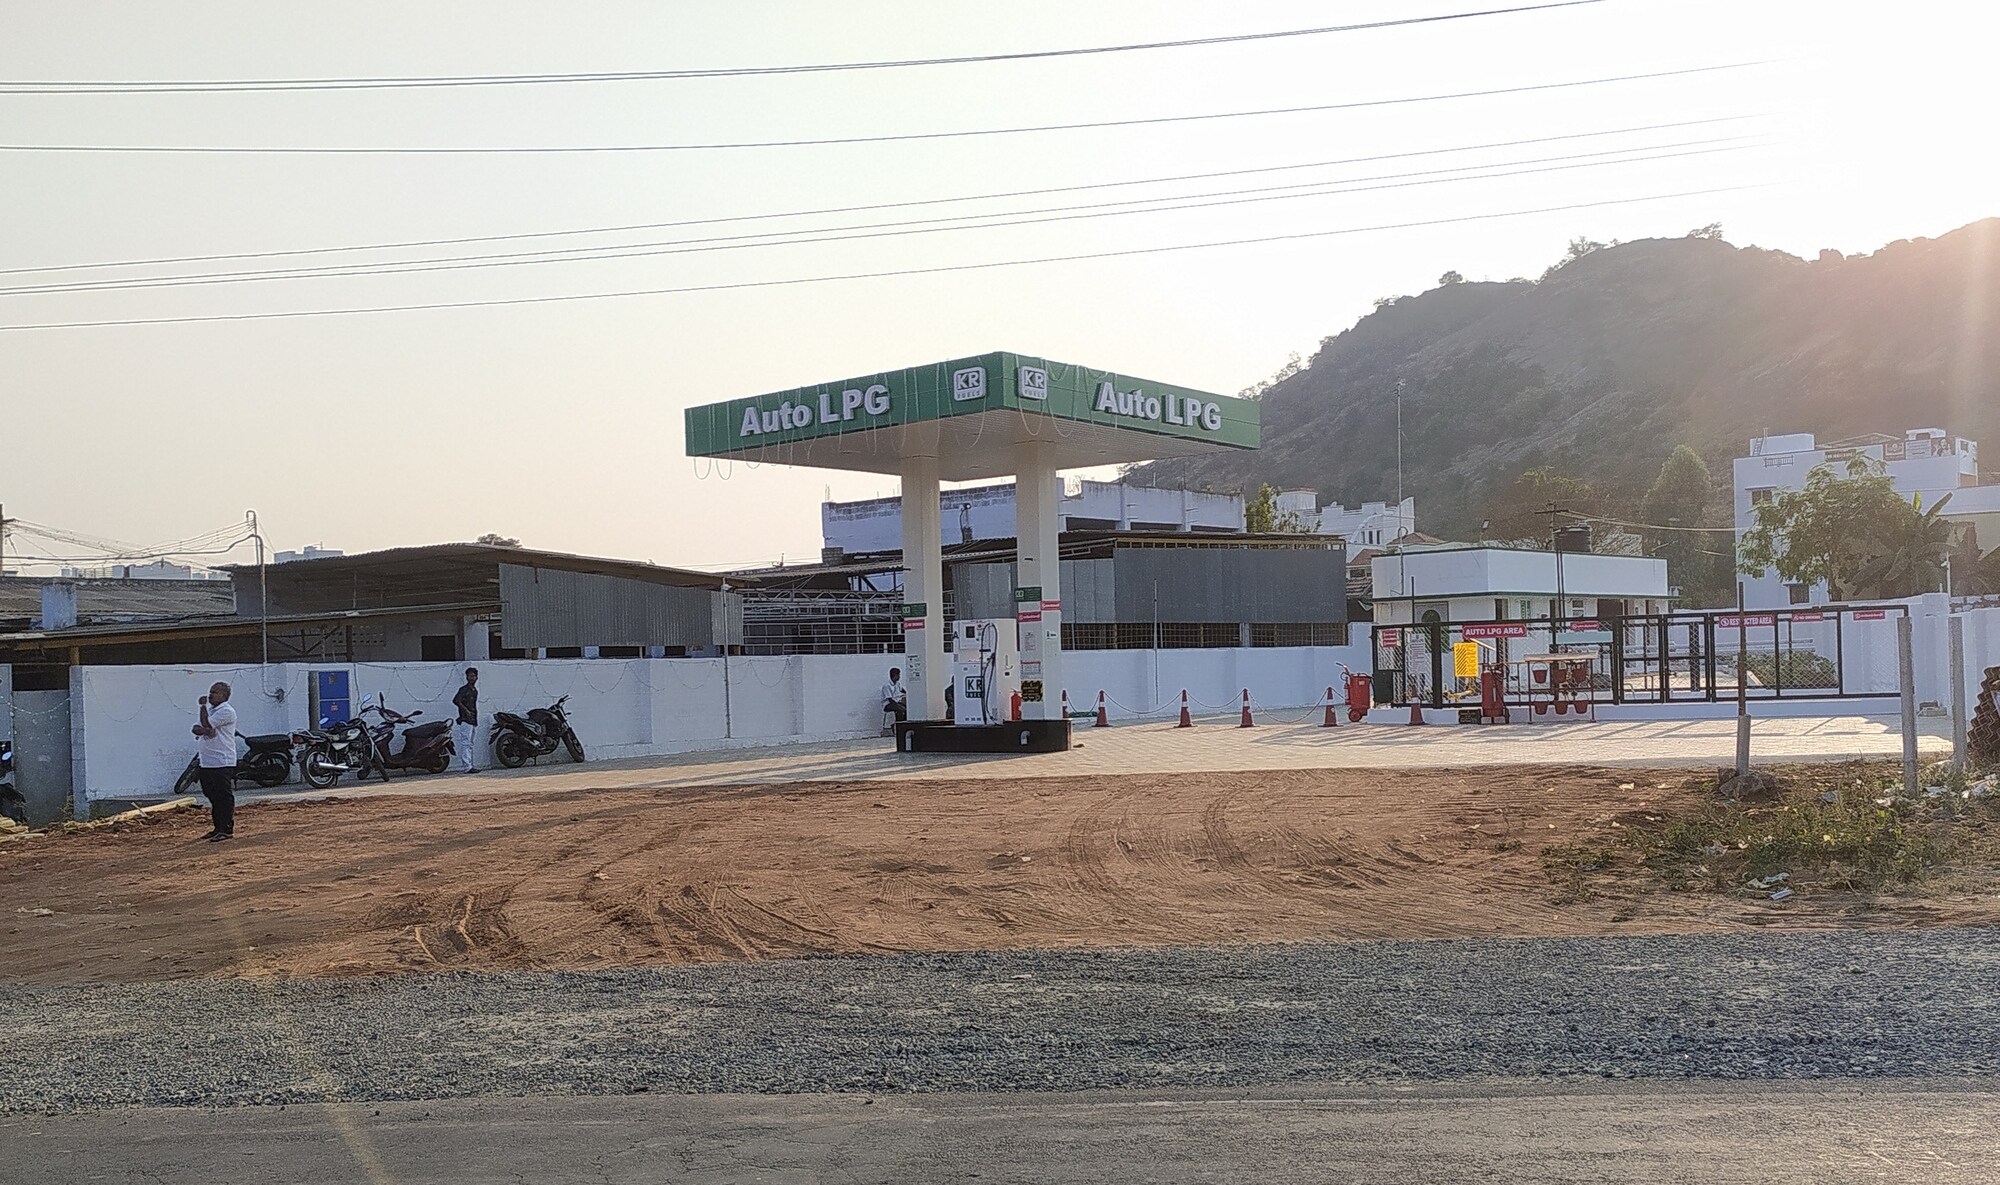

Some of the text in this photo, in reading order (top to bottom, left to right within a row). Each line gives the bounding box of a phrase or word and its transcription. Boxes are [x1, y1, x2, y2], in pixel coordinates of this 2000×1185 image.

[957, 371, 980, 390] KR
[1024, 370, 1045, 388] KR
[957, 390, 980, 399] FUELS
[740, 384, 890, 437] Auto LPG
[1096, 381, 1222, 431] Auto LPG
[1730, 616, 1772, 626] RESICTED AREA
[952, 631, 960, 640] A
[1465, 627, 1524, 636] AUTO LPG AREA
[967, 679, 982, 691] KR
